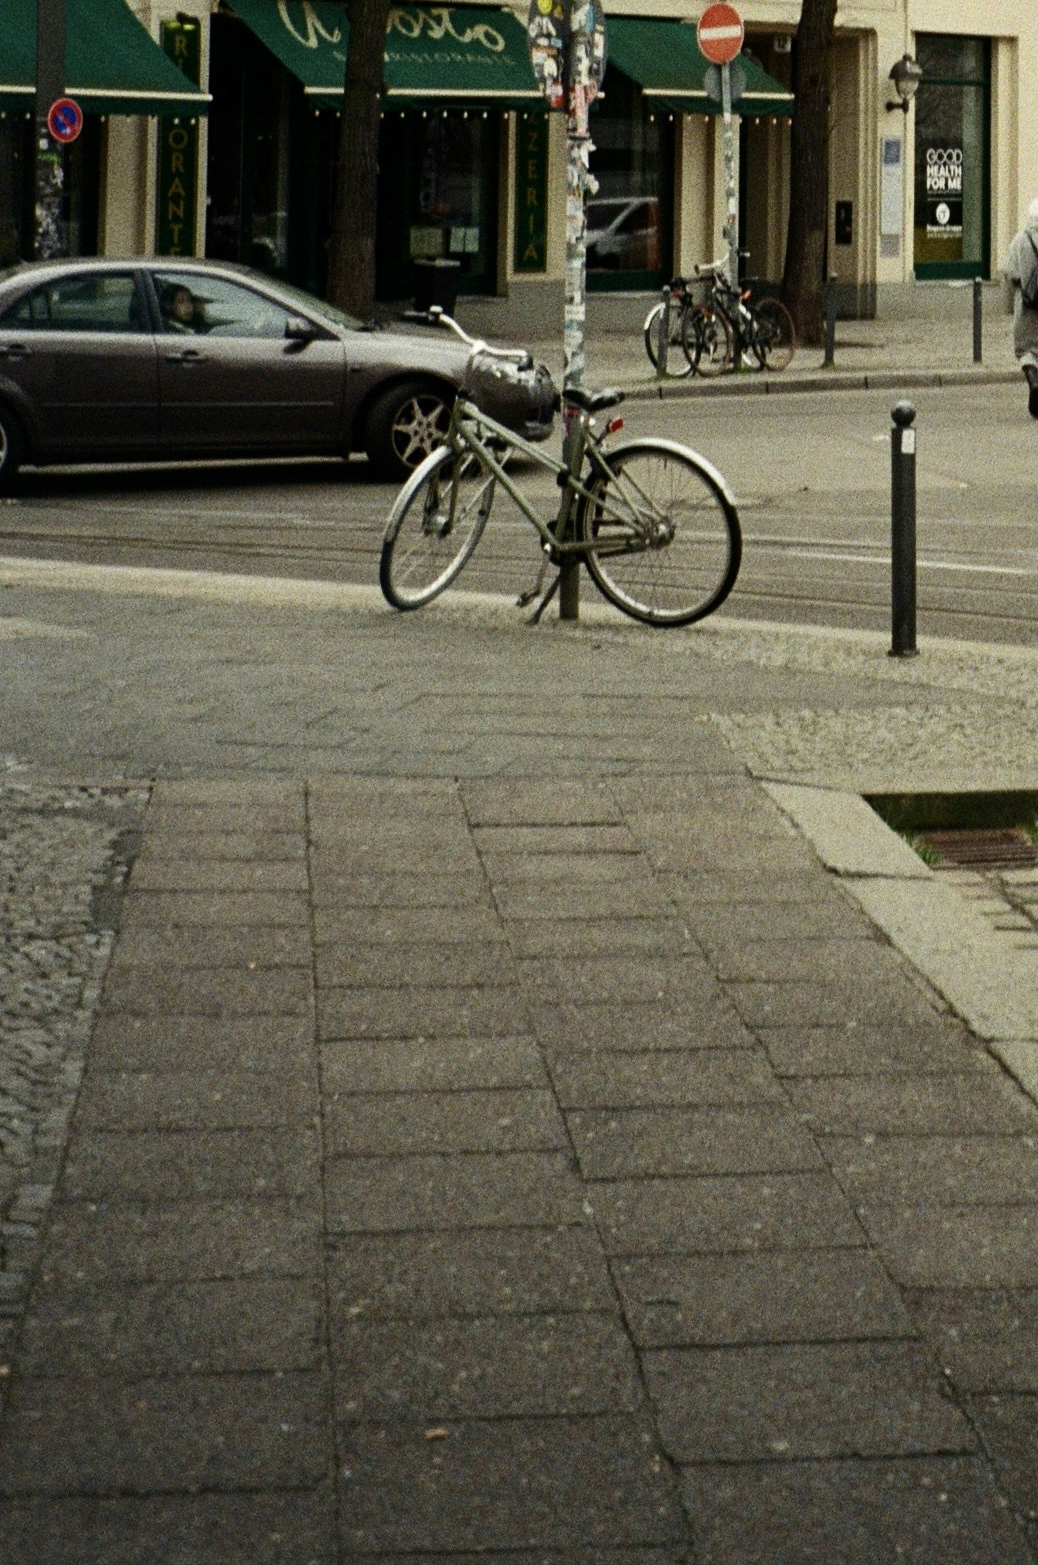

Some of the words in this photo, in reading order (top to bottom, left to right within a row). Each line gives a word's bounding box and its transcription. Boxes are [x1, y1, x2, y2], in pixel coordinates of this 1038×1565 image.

[926, 147, 963, 165] GOOD
[926, 165, 962, 178] HEALTH
[926, 176, 946, 190] FOR
[947, 177, 962, 190] ME
